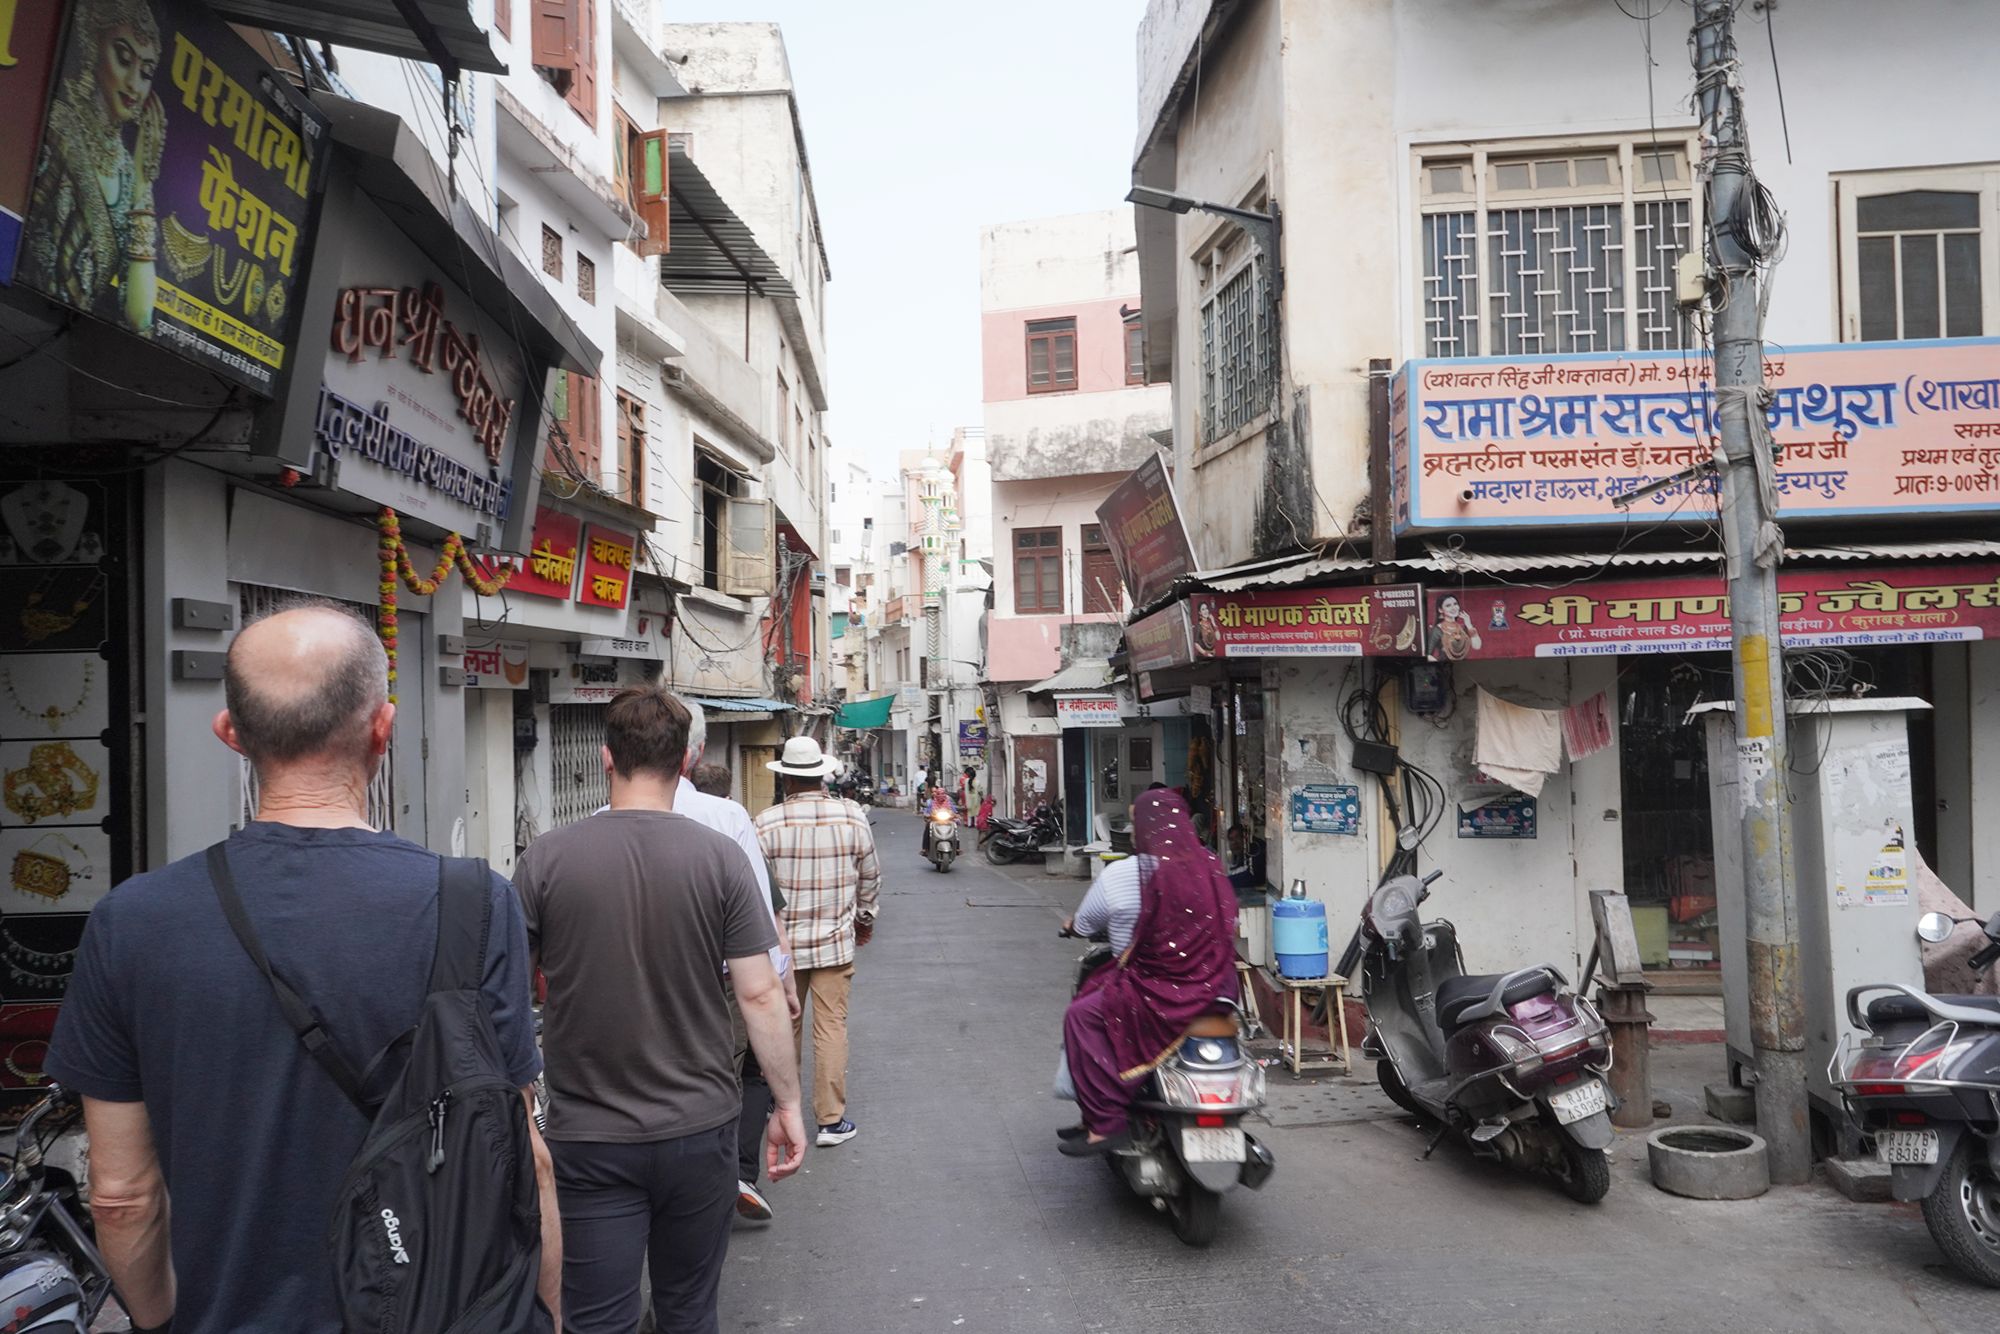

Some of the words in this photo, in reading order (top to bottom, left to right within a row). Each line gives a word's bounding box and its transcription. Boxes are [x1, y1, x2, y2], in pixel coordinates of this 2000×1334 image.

[171, 31, 311, 199] परमात्मा
[199, 144, 297, 277] फैशन
[1497, 365, 1530, 390] सिंह
[1531, 364, 1556, 386] जी
[1530, 448, 1579, 469] परम
[1580, 442, 1617, 468] संत
[1818, 430, 1848, 459] जी
[1901, 449, 1947, 467] प्रथम
[1951, 444, 1977, 465] एवं
[591, 574, 625, 602] वाला
[1218, 602, 1241, 627] श्री
[1243, 605, 1304, 626] माणक
[1306, 595, 1371, 625] ज्वैलर्स
[1514, 595, 1600, 626] श्री
[1589, 624, 1634, 639] महावीर
[1637, 625, 1666, 637] लाल
[1909, 611, 1948, 624] वाला
[1552, 643, 1577, 655] सोने
[1819, 634, 1845, 646] सभी
[1847, 633, 1875, 645] राशि
[1566, 1085, 1593, 1105] RJ27
[381, 1208, 410, 1264] Vango
